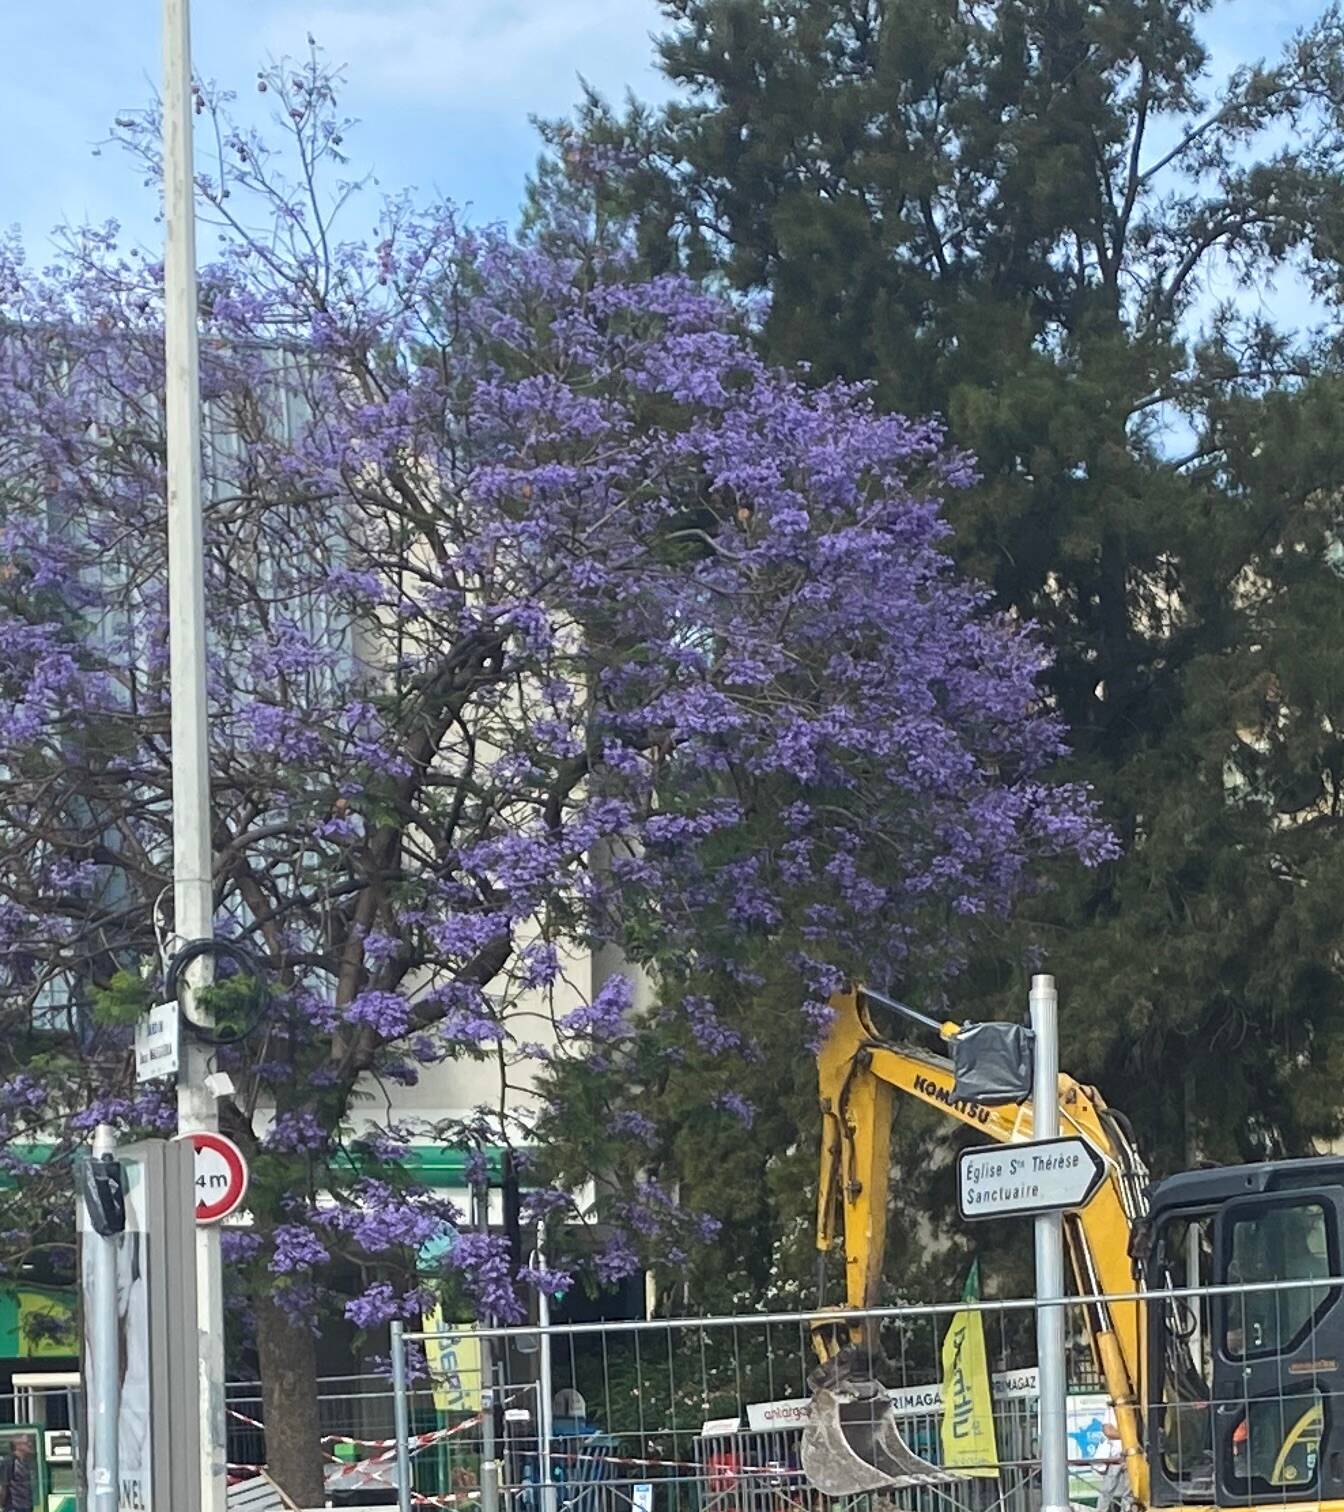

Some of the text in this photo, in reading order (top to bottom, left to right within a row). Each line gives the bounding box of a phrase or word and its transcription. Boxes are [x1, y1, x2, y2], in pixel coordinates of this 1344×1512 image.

[966, 1160, 1003, 1184] Église
[1032, 1153, 1080, 1172] Thérèse
[966, 1184, 1040, 1205] Sanctuaire
[890, 1391, 944, 1410] RIMAGA
